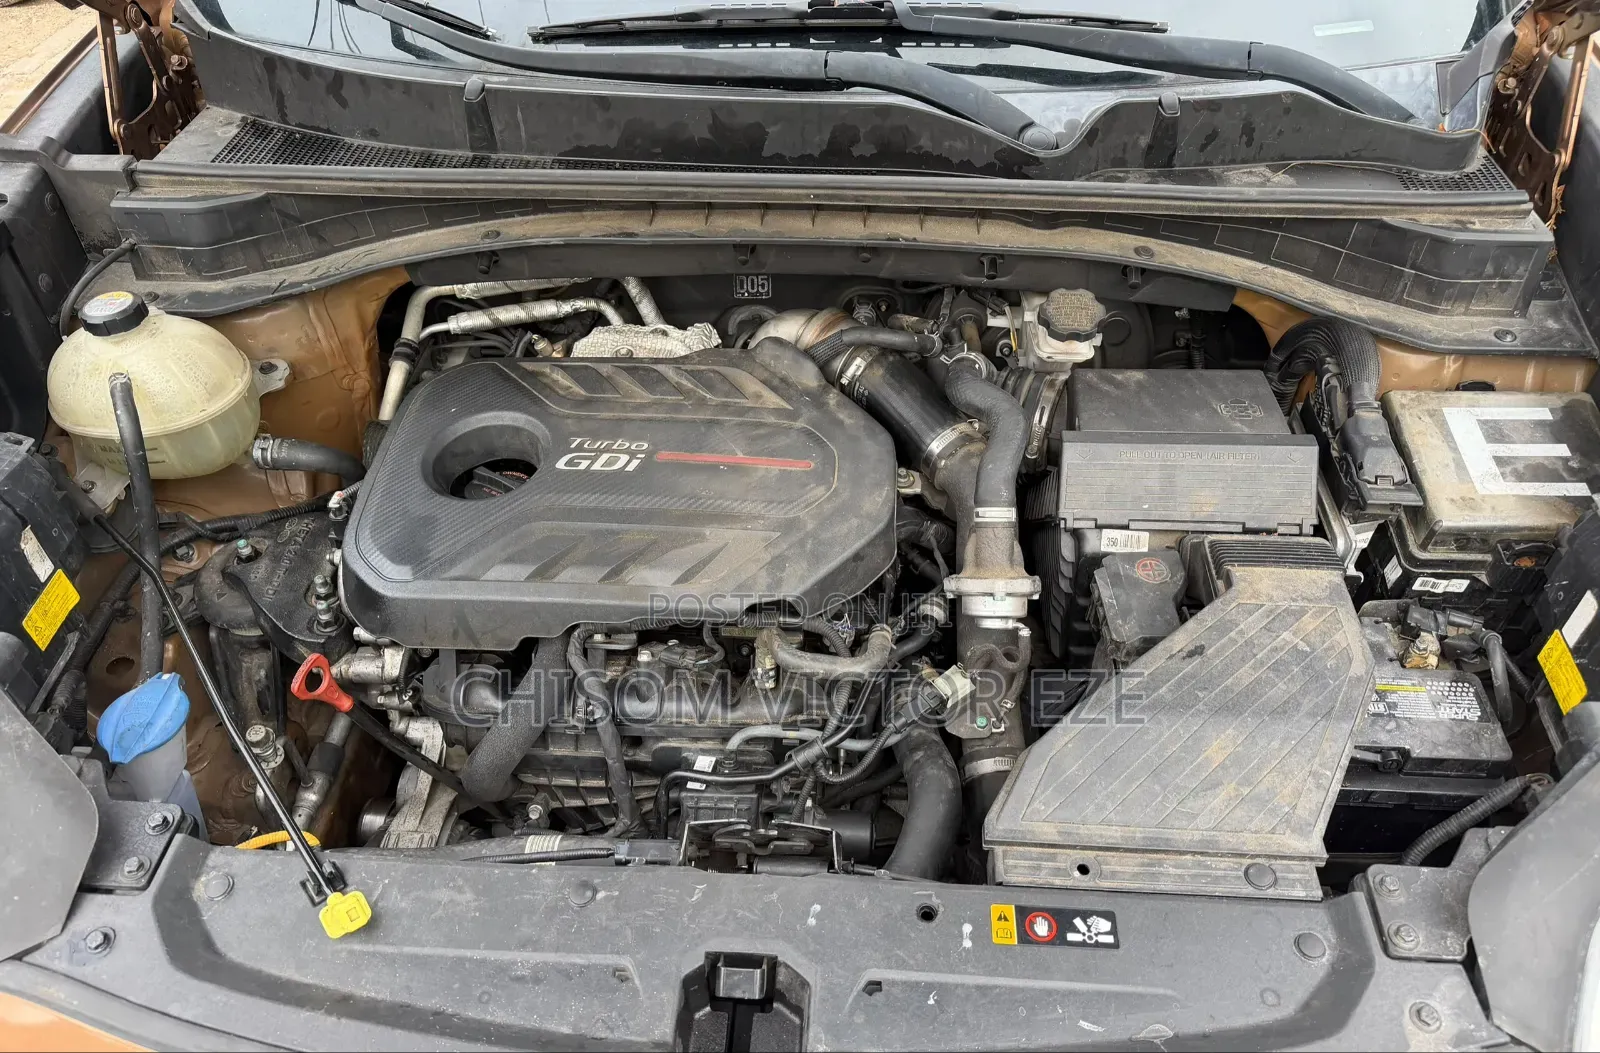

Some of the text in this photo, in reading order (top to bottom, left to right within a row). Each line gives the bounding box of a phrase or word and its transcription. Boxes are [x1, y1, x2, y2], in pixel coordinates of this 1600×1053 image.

[569, 437, 650, 451] Turbo
[1143, 451, 1161, 459] OUT
[1164, 451, 1176, 459] TO
[1443, 407, 1592, 496] E
[555, 452, 646, 472] GDi
[1106, 537, 1119, 548] 350
